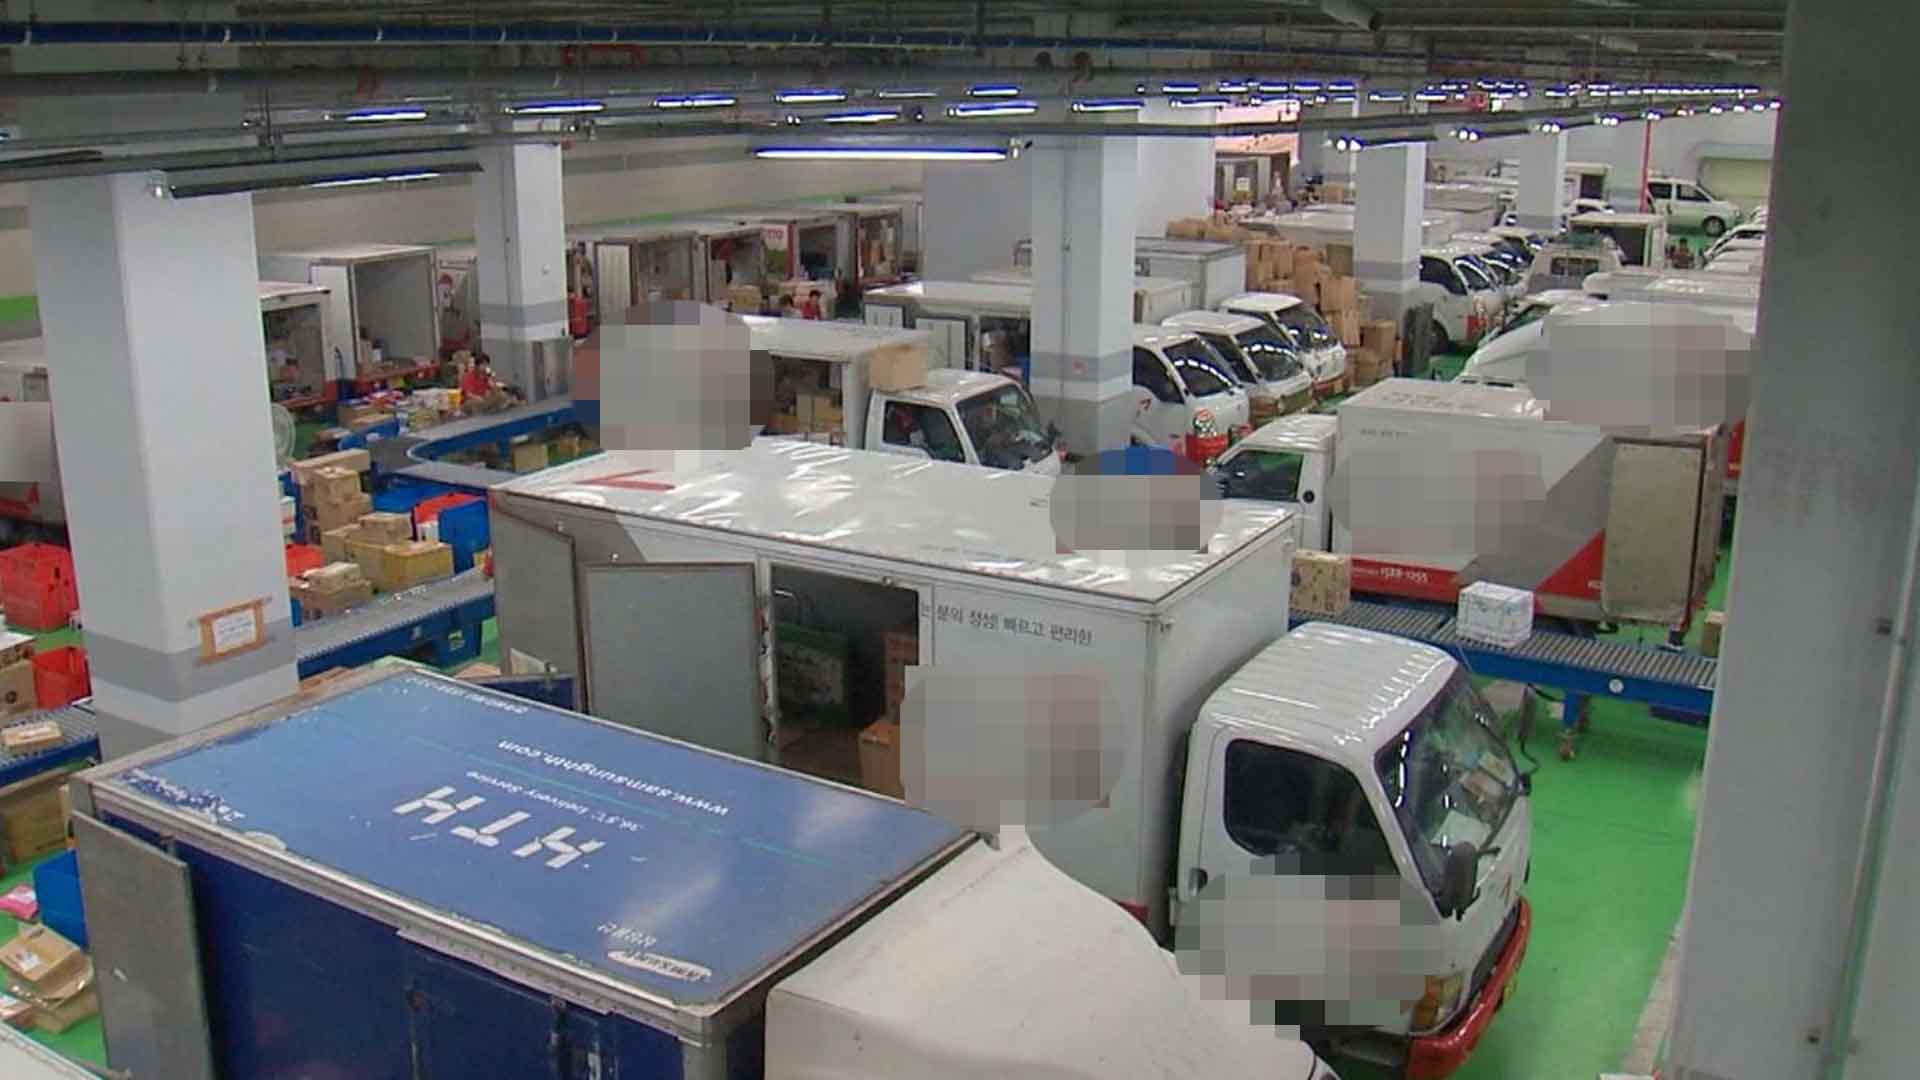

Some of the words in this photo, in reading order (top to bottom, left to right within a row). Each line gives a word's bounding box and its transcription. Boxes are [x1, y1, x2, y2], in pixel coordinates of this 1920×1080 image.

[969, 610, 996, 631] 정성
[1003, 616, 1045, 637] 빠르고
[1049, 625, 1093, 646] 편리한
[465, 770, 523, 794] Service
[498, 740, 730, 817] www.samsunghth.com
[523, 789, 588, 816] Delivery
